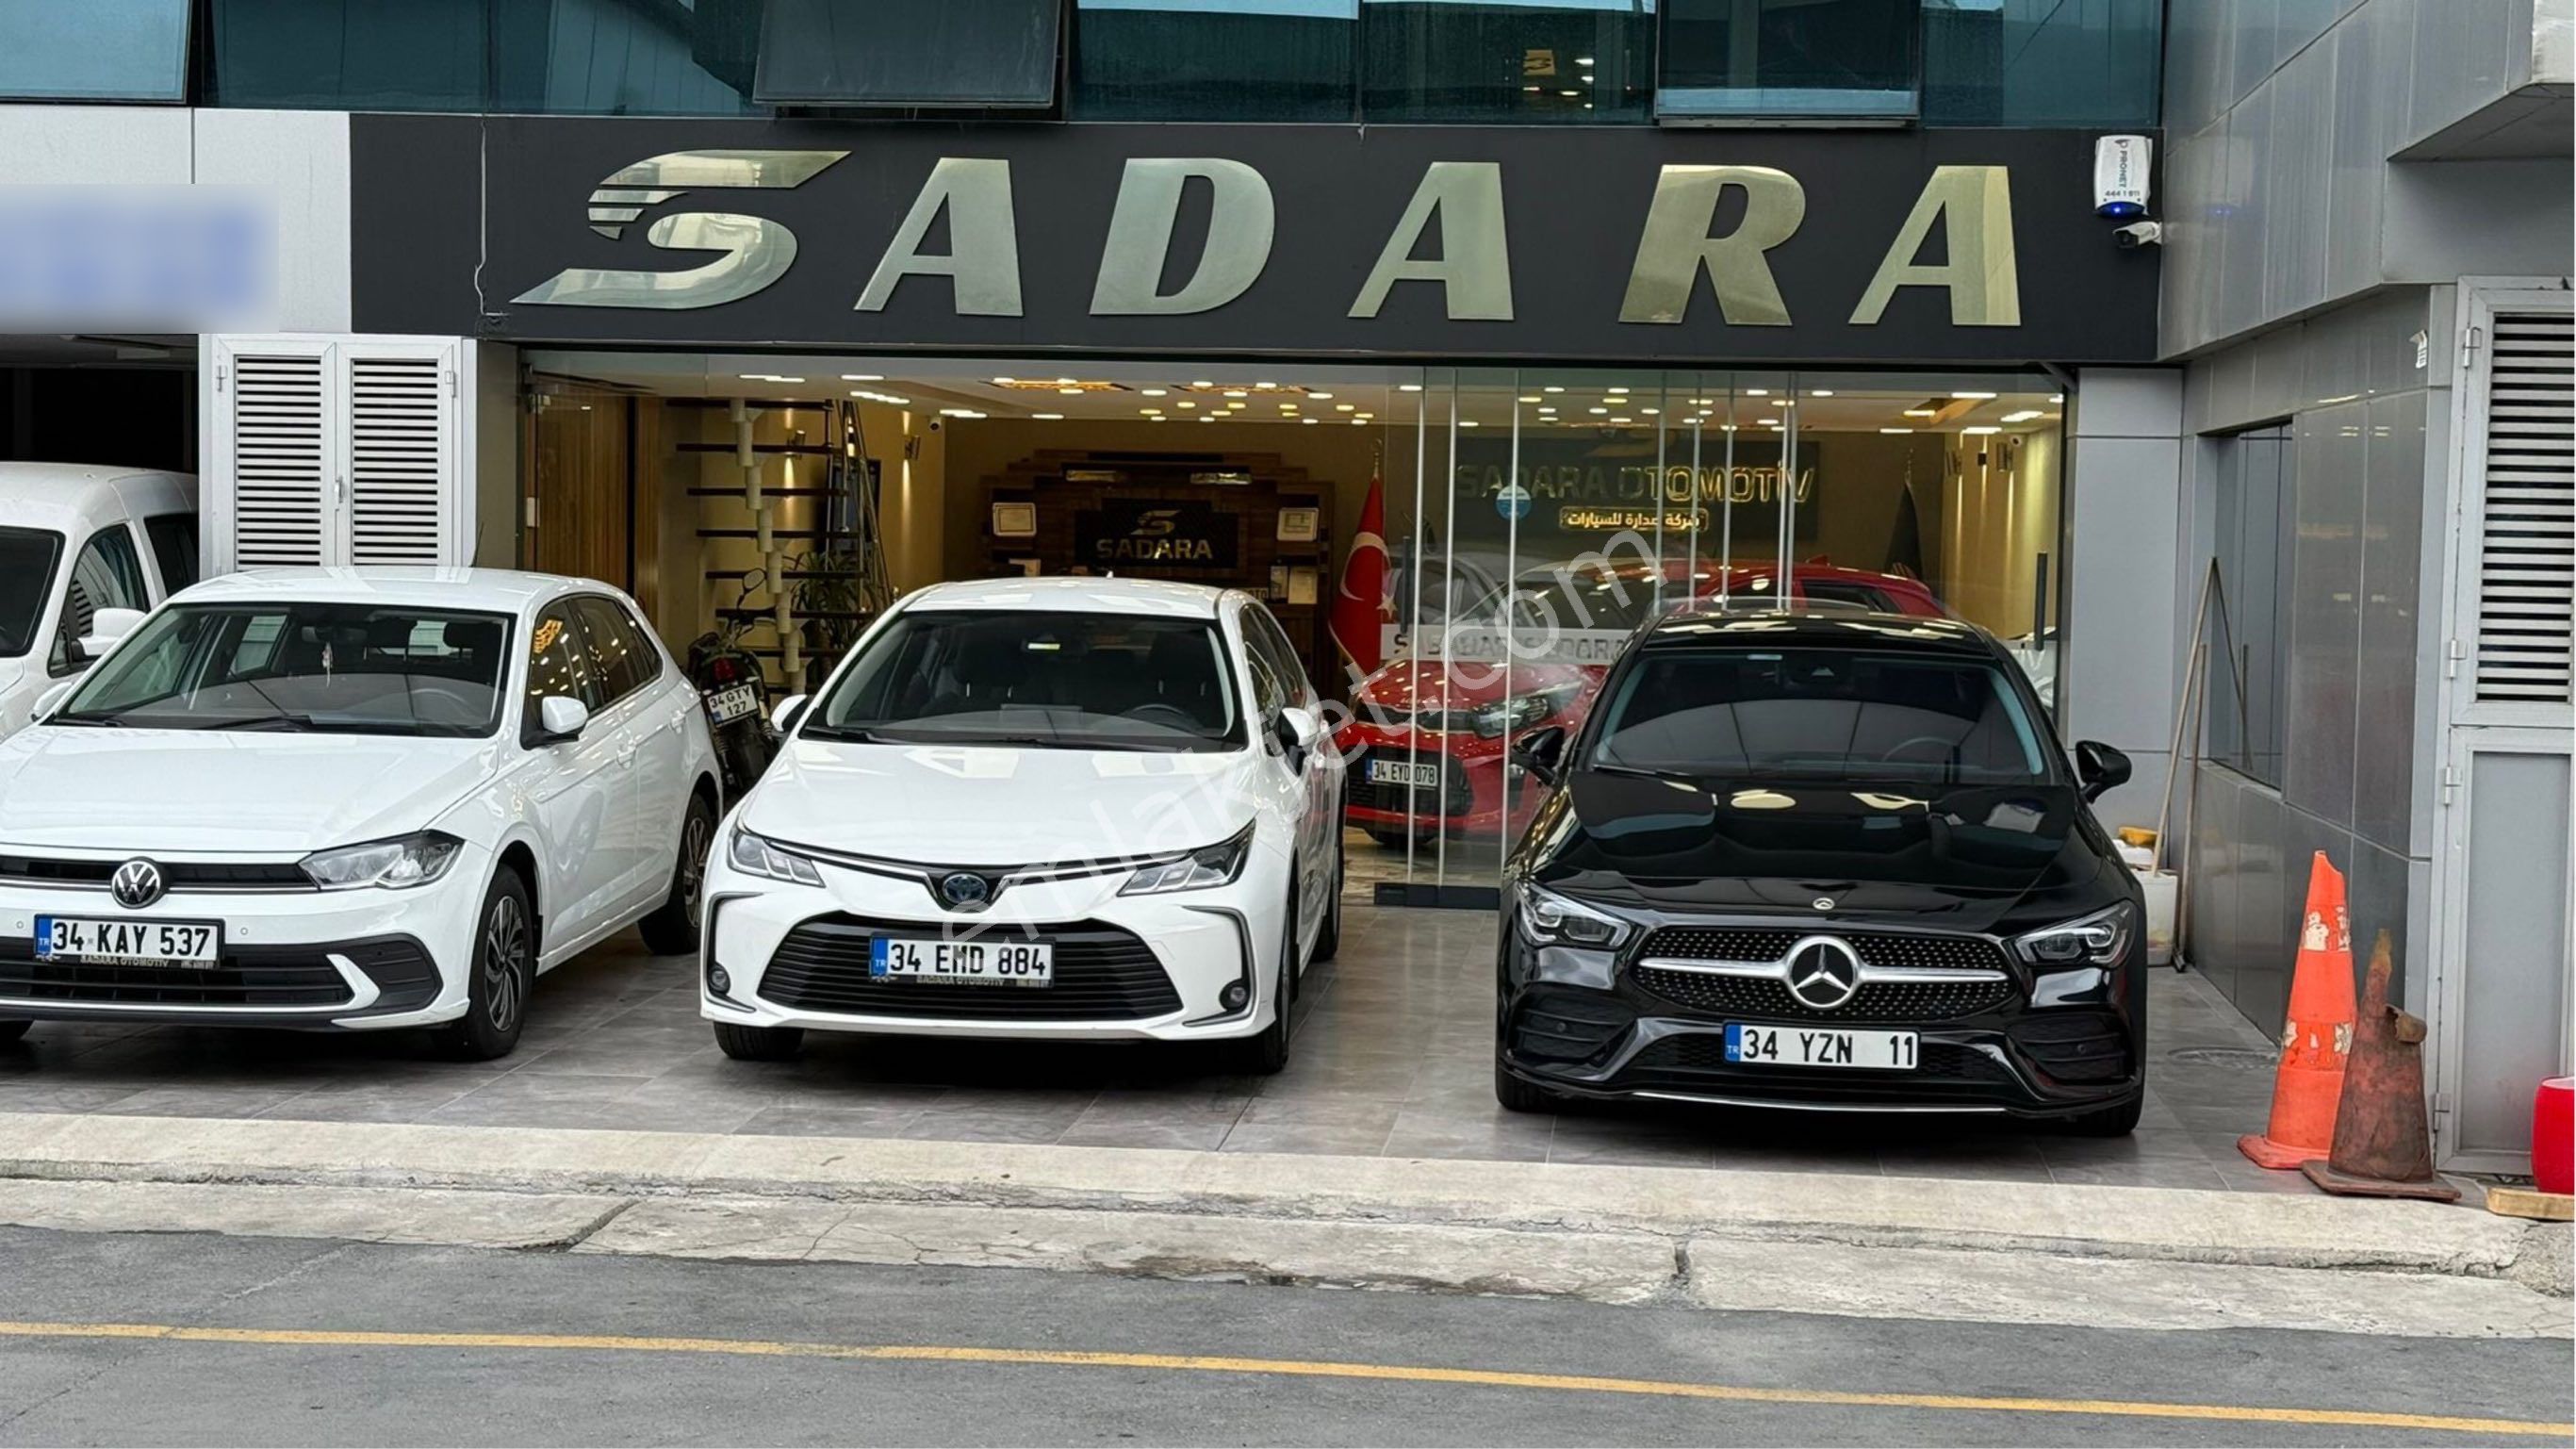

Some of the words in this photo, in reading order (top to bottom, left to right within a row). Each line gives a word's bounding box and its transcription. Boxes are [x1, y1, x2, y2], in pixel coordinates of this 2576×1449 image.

[2119, 150, 2127, 187] PRONET
[510, 150, 2020, 327] SADARA
[1096, 538, 1213, 560] SADARA
[709, 697, 725, 709] 34
[726, 687, 751, 703] GTY
[727, 700, 747, 716] 127
[1374, 762, 1387, 780] 34
[1415, 766, 1436, 784] 078
[53, 922, 84, 952] 34
[97, 924, 147, 954] KAY
[160, 928, 210, 957] 537
[890, 944, 922, 972] 34
[997, 947, 1046, 977] 884
[1727, 1044, 1740, 1055] TR
[1744, 1029, 1779, 1061] 34
[1799, 1032, 1853, 1064] YZN
[1889, 1035, 1913, 1066] 11
